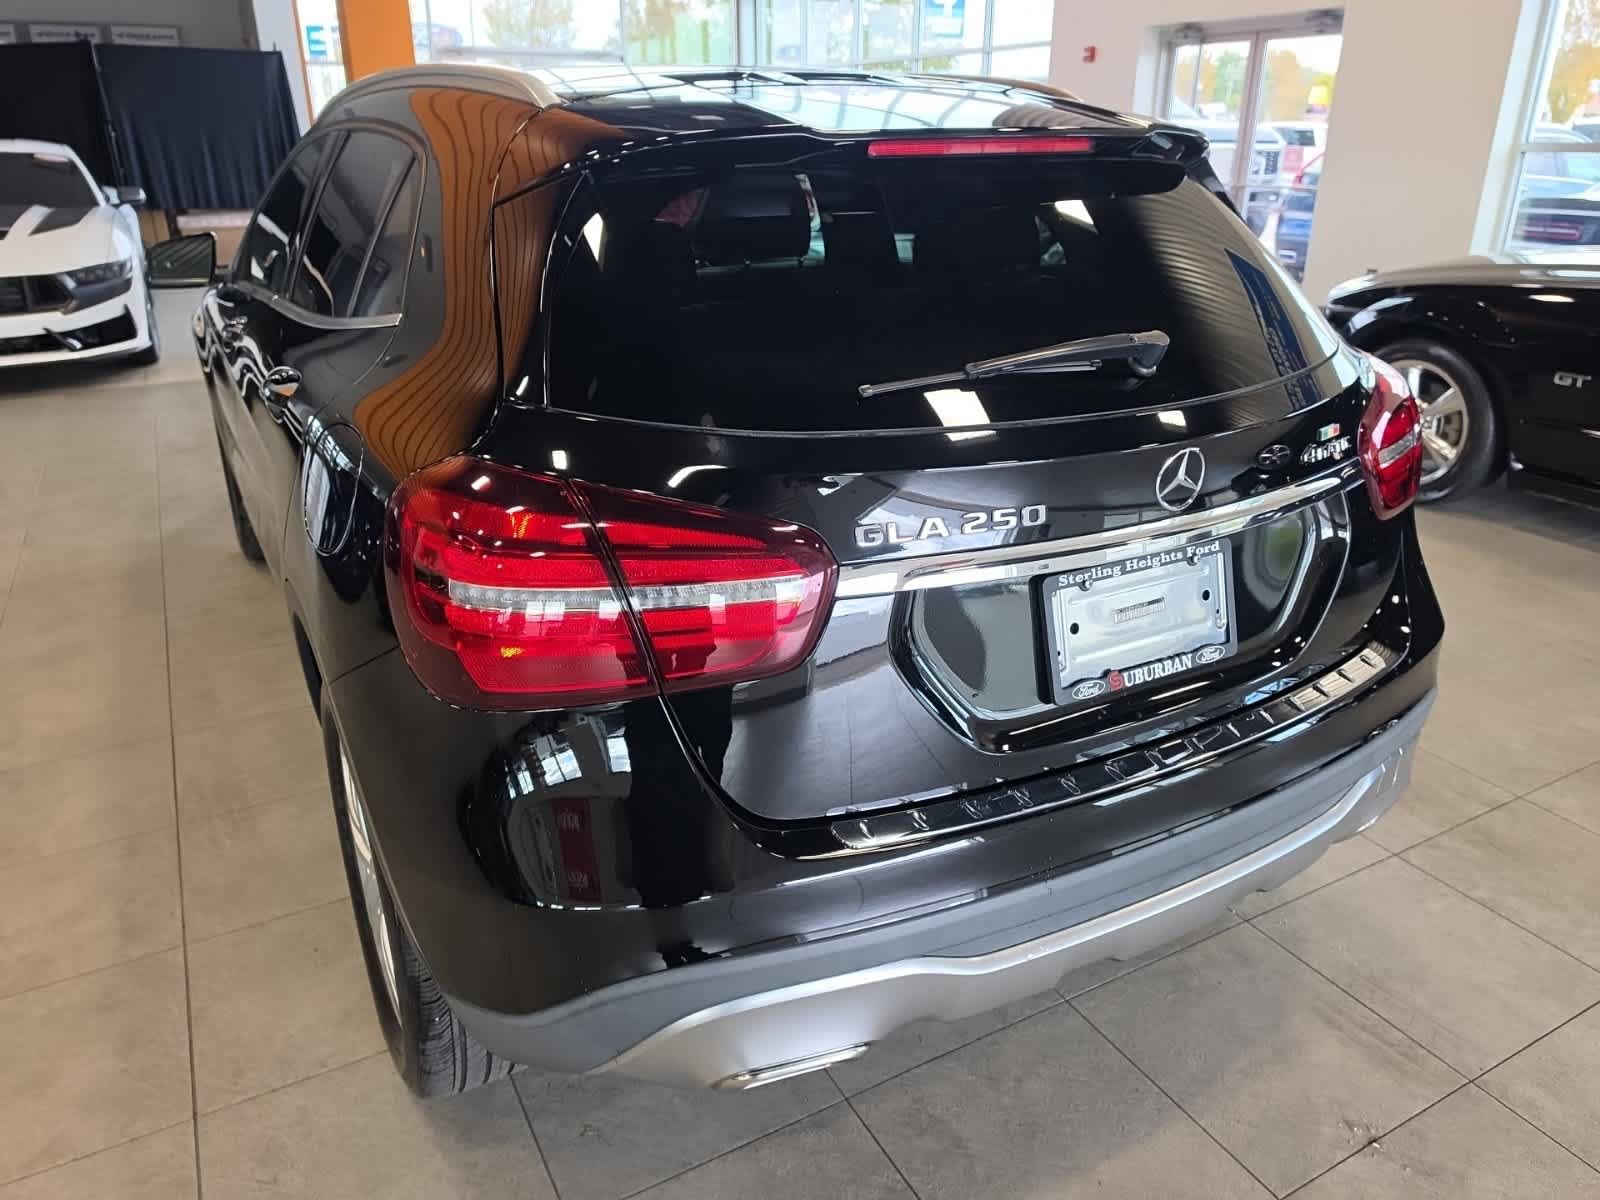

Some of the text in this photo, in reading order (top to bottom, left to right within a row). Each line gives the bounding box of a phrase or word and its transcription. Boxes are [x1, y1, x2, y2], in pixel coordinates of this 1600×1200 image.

[1553, 371, 1592, 389] GT
[854, 504, 1047, 548] GLA 250
[1058, 541, 1220, 587] Sterling Heights Ford
[1078, 647, 1221, 698] Ford SUBURBAN Ford
